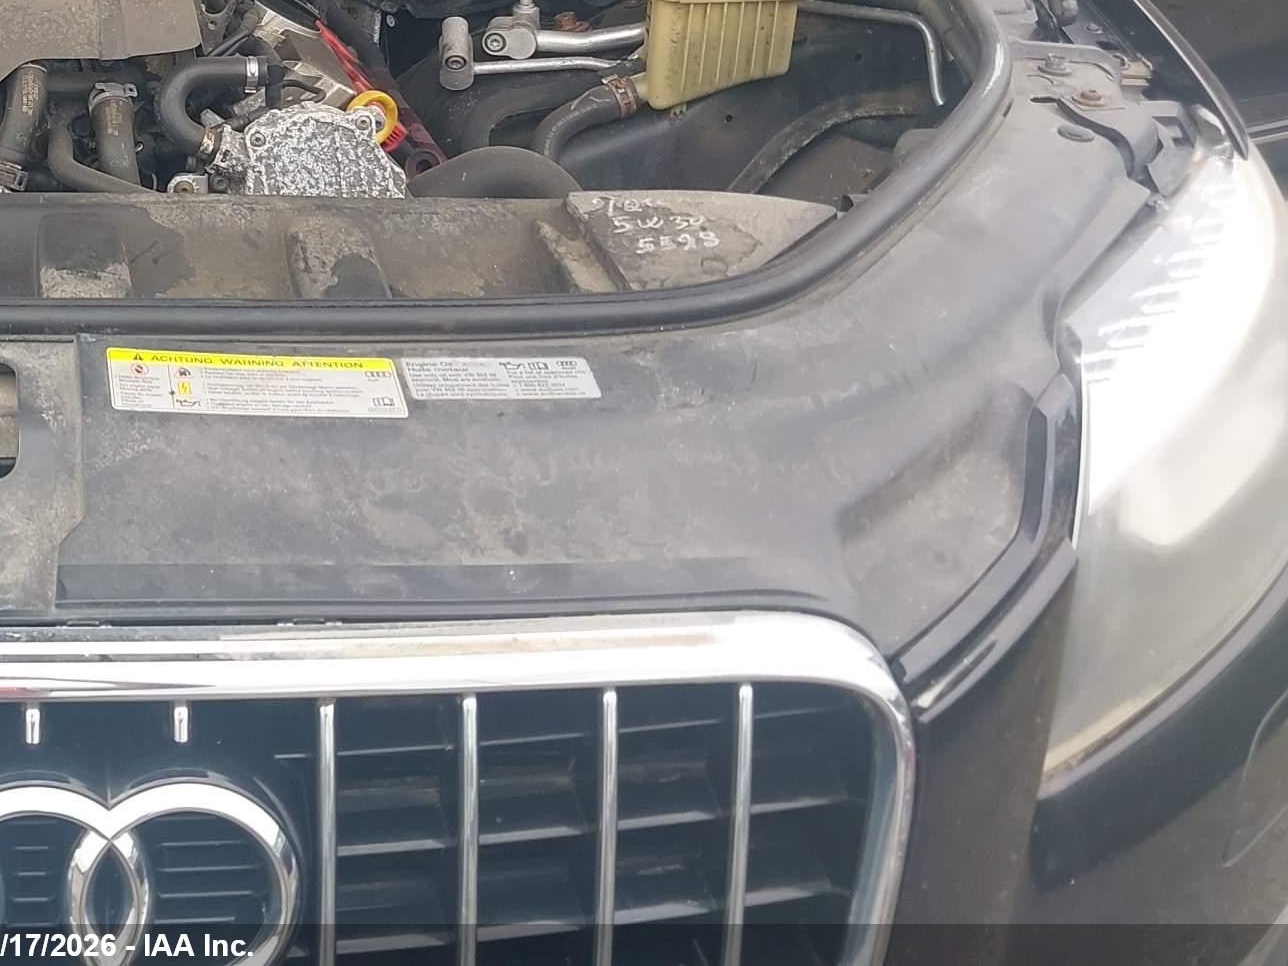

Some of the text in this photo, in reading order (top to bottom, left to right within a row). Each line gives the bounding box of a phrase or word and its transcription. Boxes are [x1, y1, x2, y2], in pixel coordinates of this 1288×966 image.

[151, 354, 364, 370] ACHTUNG WARNING ATTENTION
